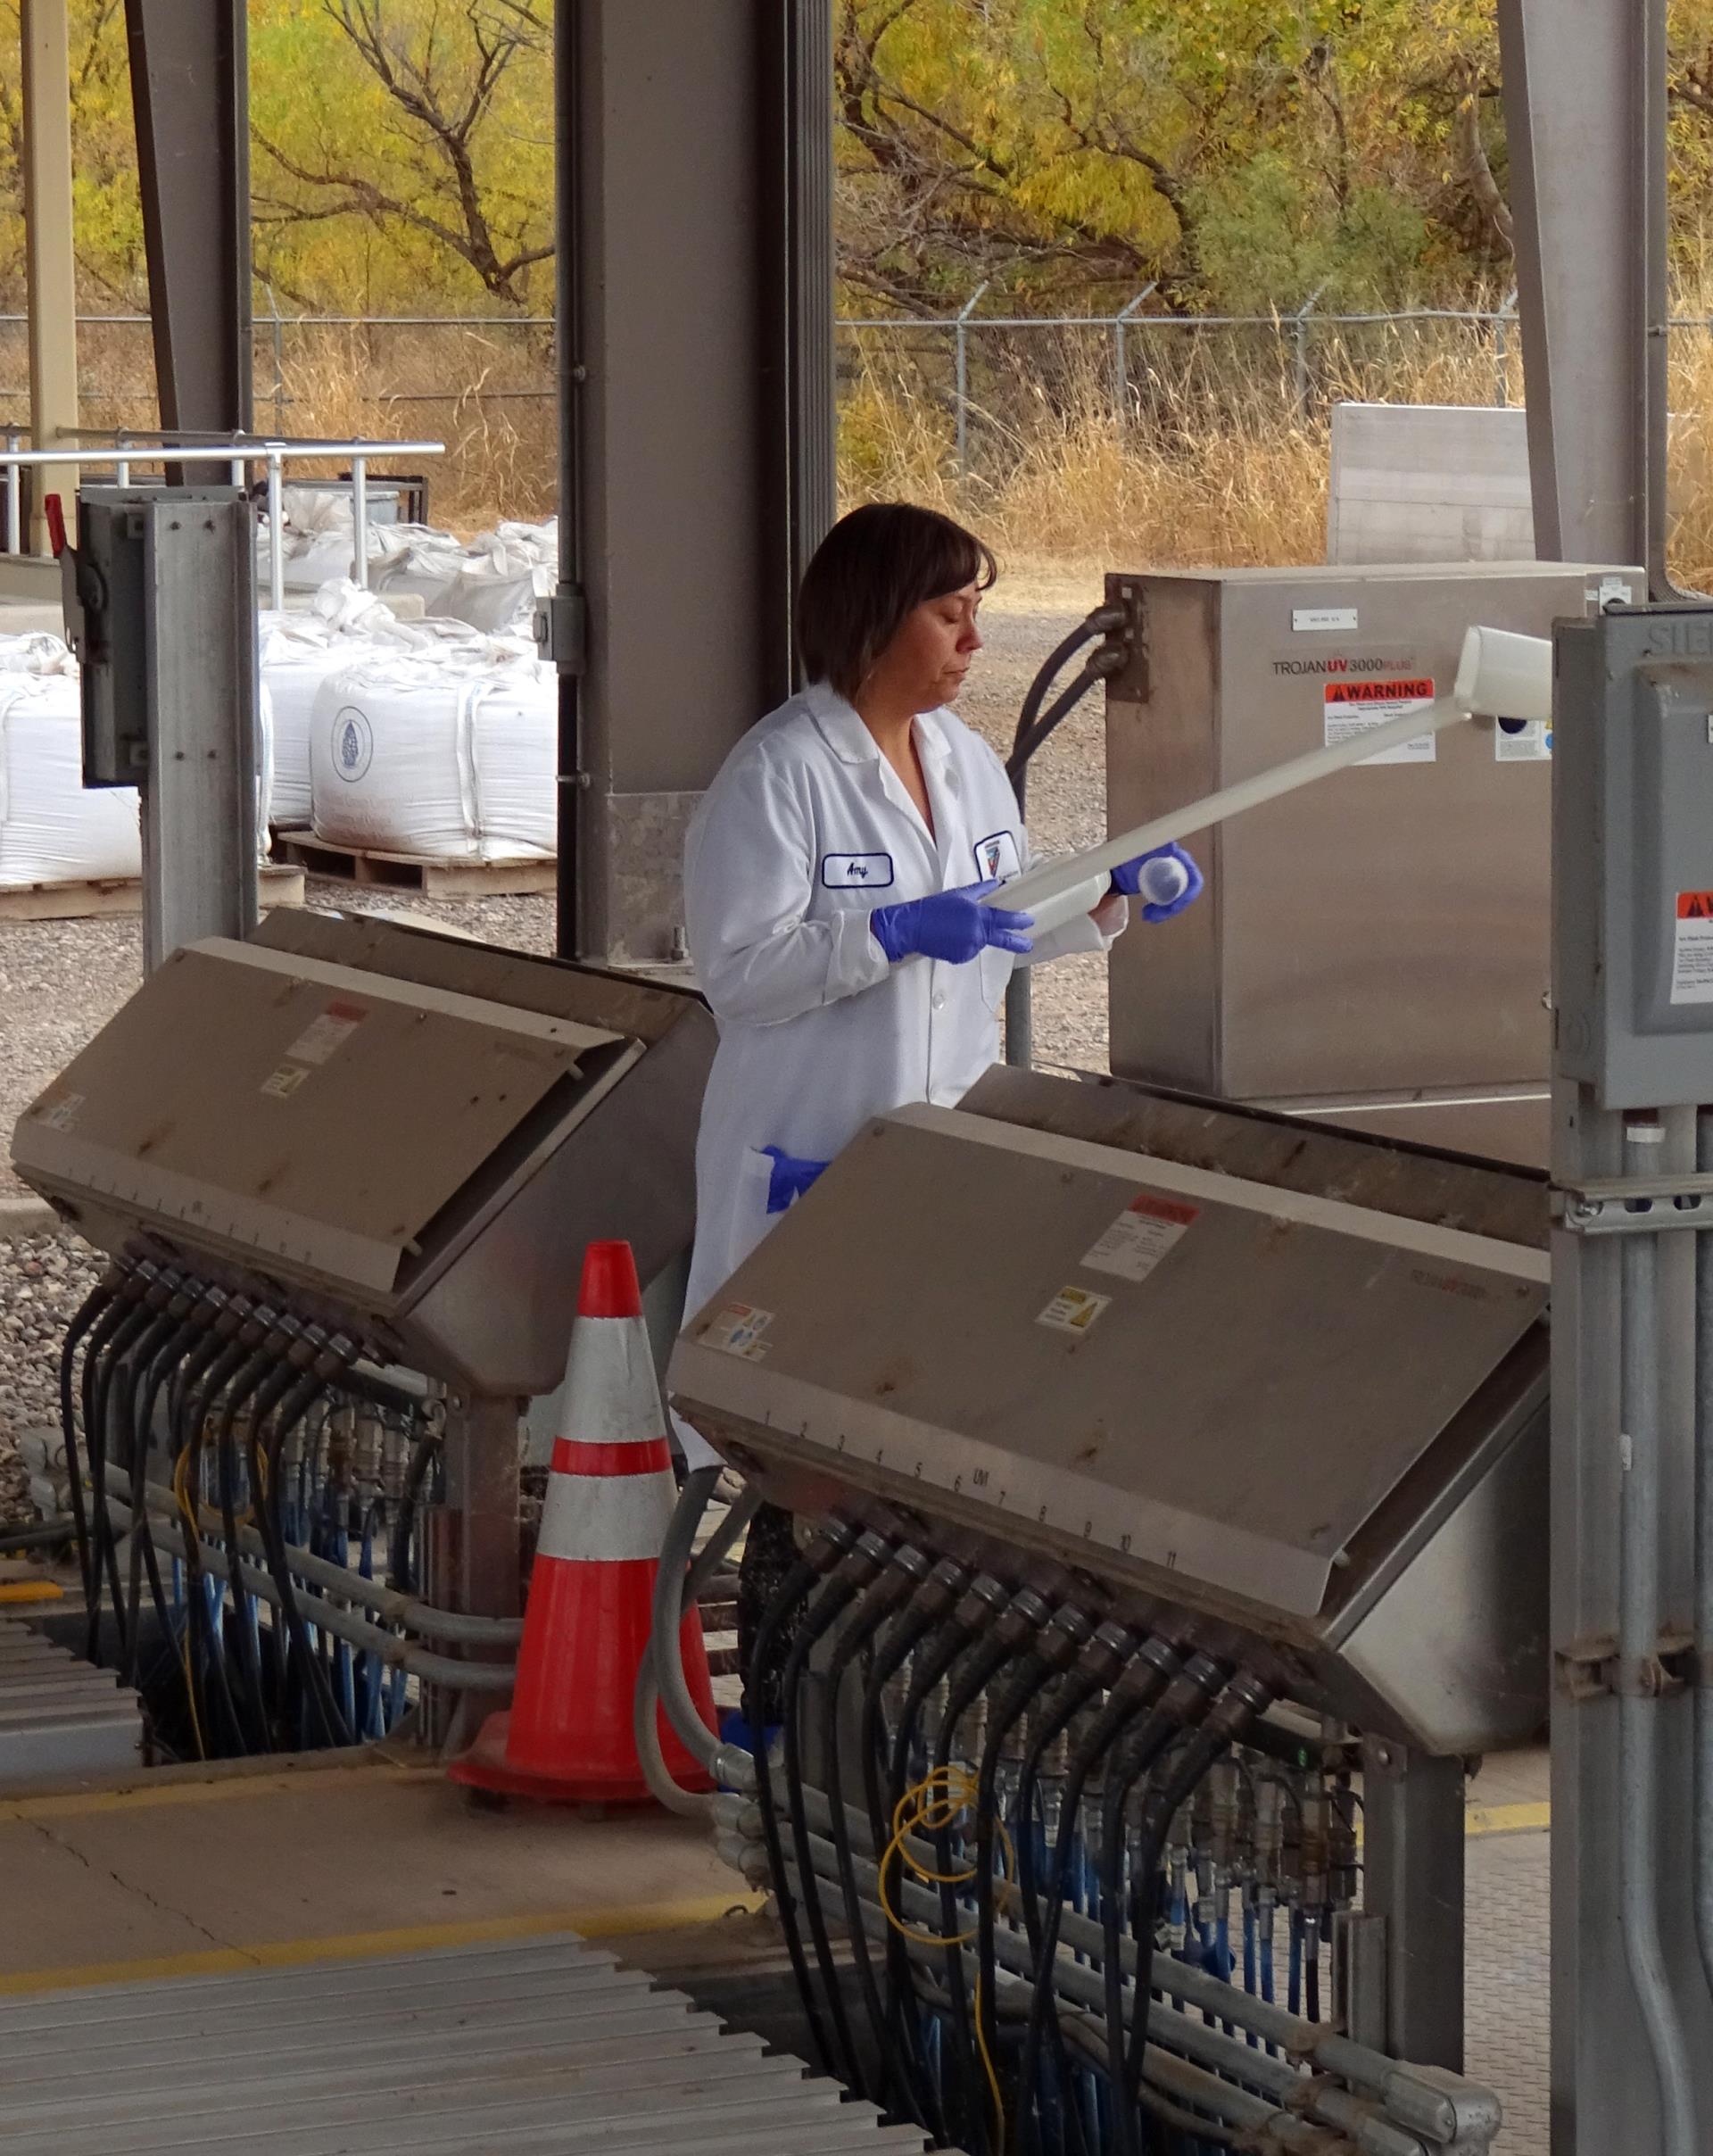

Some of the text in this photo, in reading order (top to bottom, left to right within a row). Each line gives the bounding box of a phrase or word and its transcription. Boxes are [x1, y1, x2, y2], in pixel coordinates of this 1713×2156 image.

[1347, 683, 1428, 701] WARNING
[847, 862, 868, 879] Amy
[953, 1475, 962, 1493] 6
[998, 1490, 1006, 1507] 7
[1039, 1505, 1047, 1522] 8
